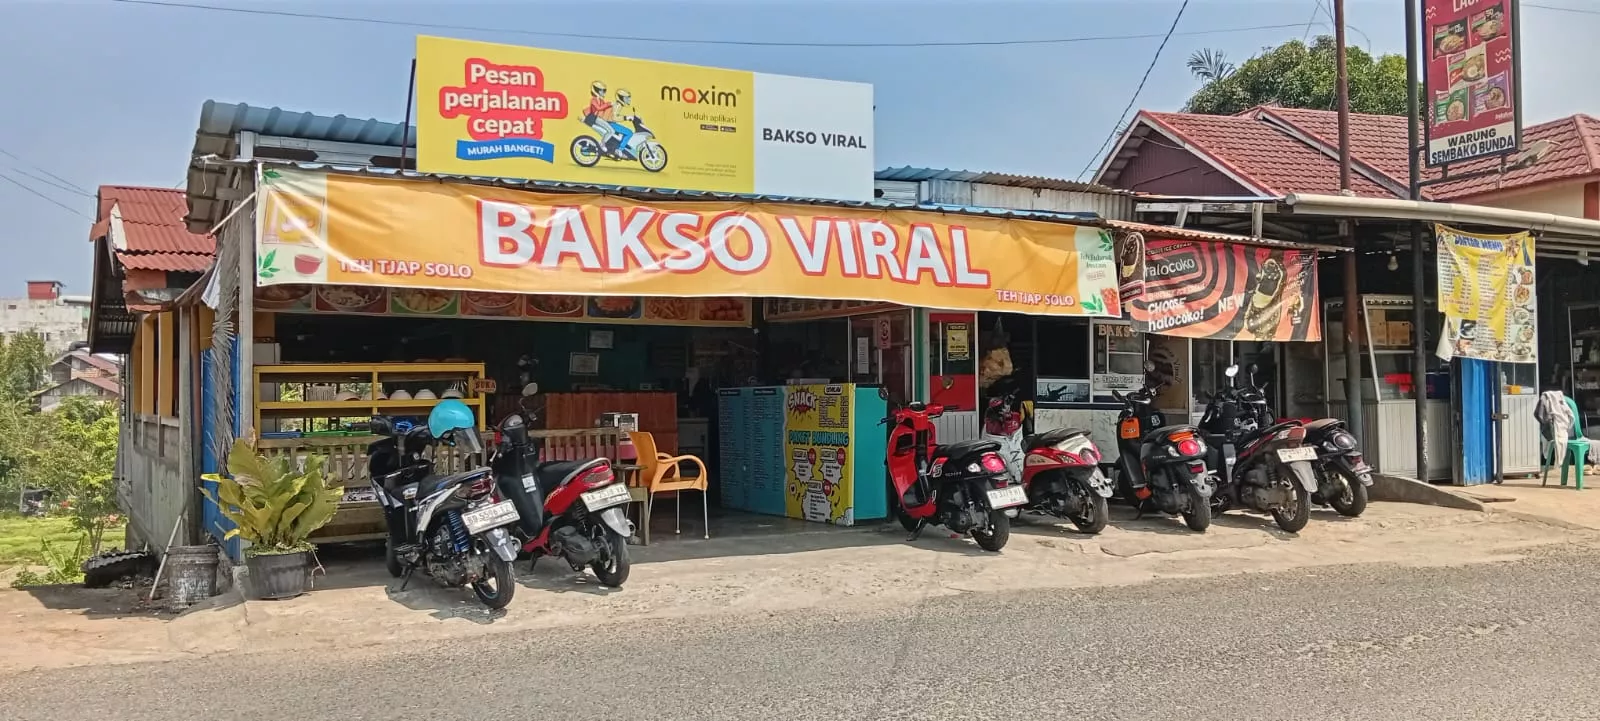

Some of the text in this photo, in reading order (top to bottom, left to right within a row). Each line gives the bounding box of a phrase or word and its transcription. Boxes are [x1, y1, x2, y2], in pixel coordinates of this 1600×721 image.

[470, 63, 536, 86] Pesan
[444, 88, 561, 113] perjalanan
[661, 84, 737, 108] maxim
[472, 117, 535, 138] cepat
[683, 111, 737, 124] Unduh aplikasi
[762, 127, 867, 149] BAKSO VIRAL
[1447, 127, 1497, 147] WARUNG
[467, 144, 544, 156] MURAH BANGET!
[1431, 135, 1515, 164] SEMBAKO BUNDA
[478, 199, 991, 289] BAKSO VIRAL
[339, 258, 473, 279] TEH TJAP SOLO
[996, 289, 1075, 306] TEH TJAP SOLO
[1148, 296, 1187, 314] CHOOSE
[1217, 292, 1246, 315] NEW
[1148, 308, 1205, 332] halocoko!
[787, 390, 816, 411] SNACK
[788, 430, 850, 447] PAKET BUNDLING
